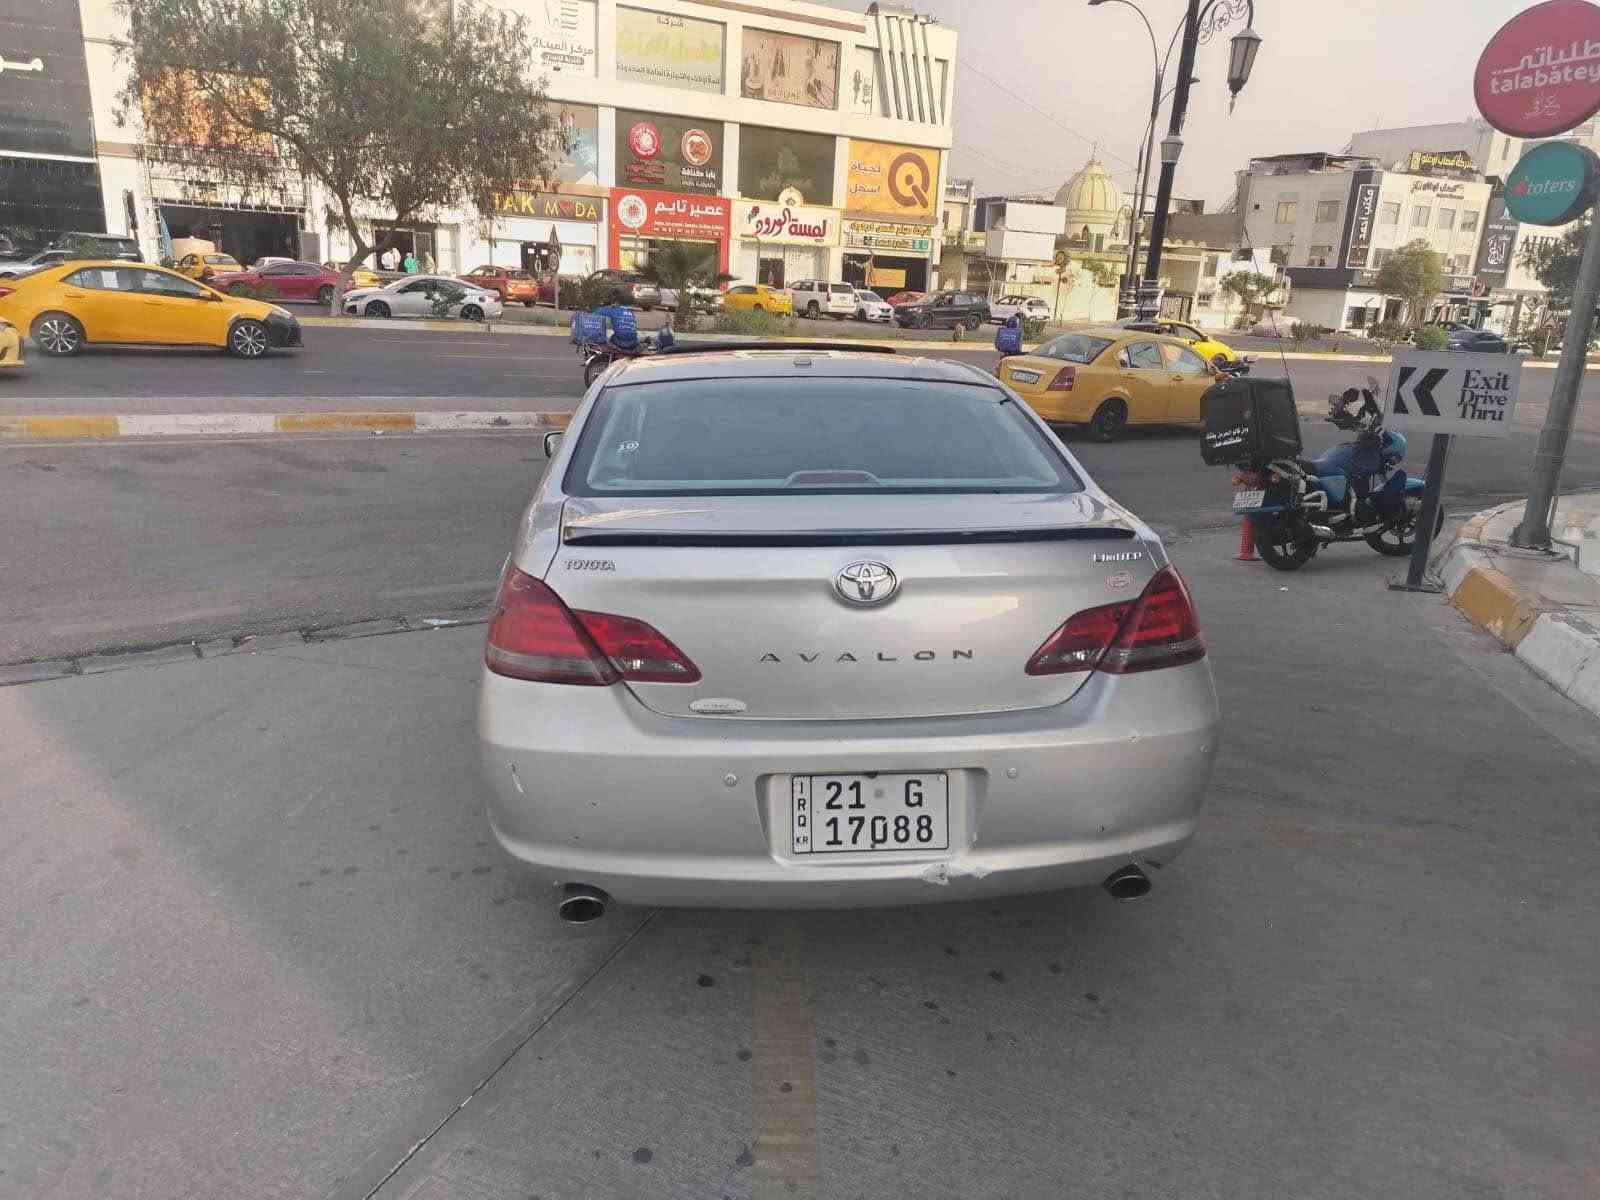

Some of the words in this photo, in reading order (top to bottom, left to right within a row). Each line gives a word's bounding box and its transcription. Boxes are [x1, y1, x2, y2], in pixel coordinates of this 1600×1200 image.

[655, 199, 689, 216] تايم
[690, 203, 724, 218] عصير
[788, 218, 827, 242] لمسة
[1462, 369, 1511, 391] Exit
[1460, 389, 1508, 405] Drive
[1457, 401, 1504, 421] Thru
[565, 559, 616, 571] TOYOTA
[759, 649, 974, 663] AVALON
[825, 780, 866, 809] 21
[904, 779, 923, 807] G
[826, 814, 933, 845] 17088
